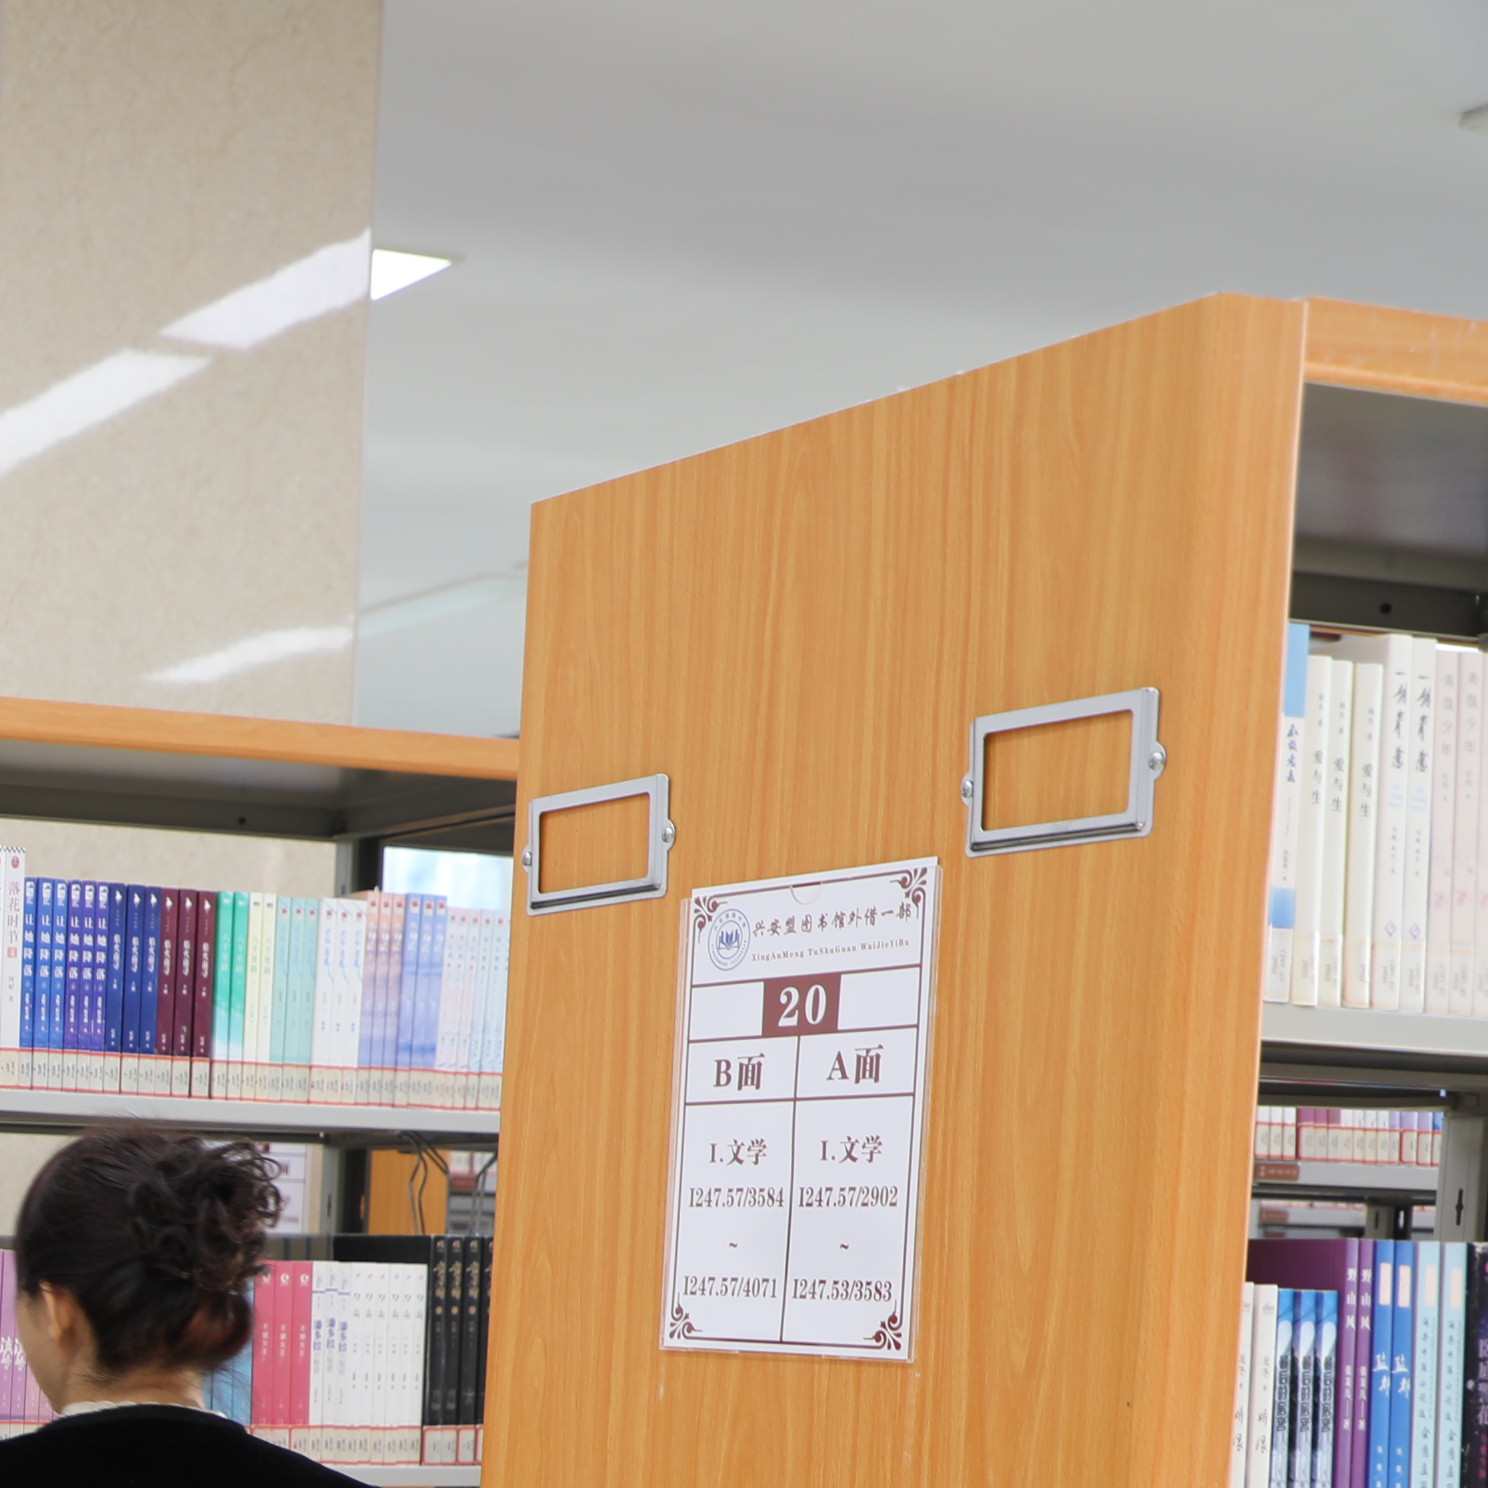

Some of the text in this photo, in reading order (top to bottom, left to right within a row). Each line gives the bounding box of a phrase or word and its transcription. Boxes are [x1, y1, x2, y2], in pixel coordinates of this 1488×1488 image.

[752, 901, 913, 937] 兴安盟图书馆外借一部
[751, 939, 910, 962] XingAnMeng TuShuGuan WaiJieYiBu
[777, 984, 827, 1028] 20
[713, 1052, 766, 1092] B面
[825, 1044, 885, 1086] A面
[689, 1185, 785, 1210] I247.57/3584
[797, 1185, 899, 1210] I247.57/2902
[683, 1275, 777, 1300] I247.57/4071
